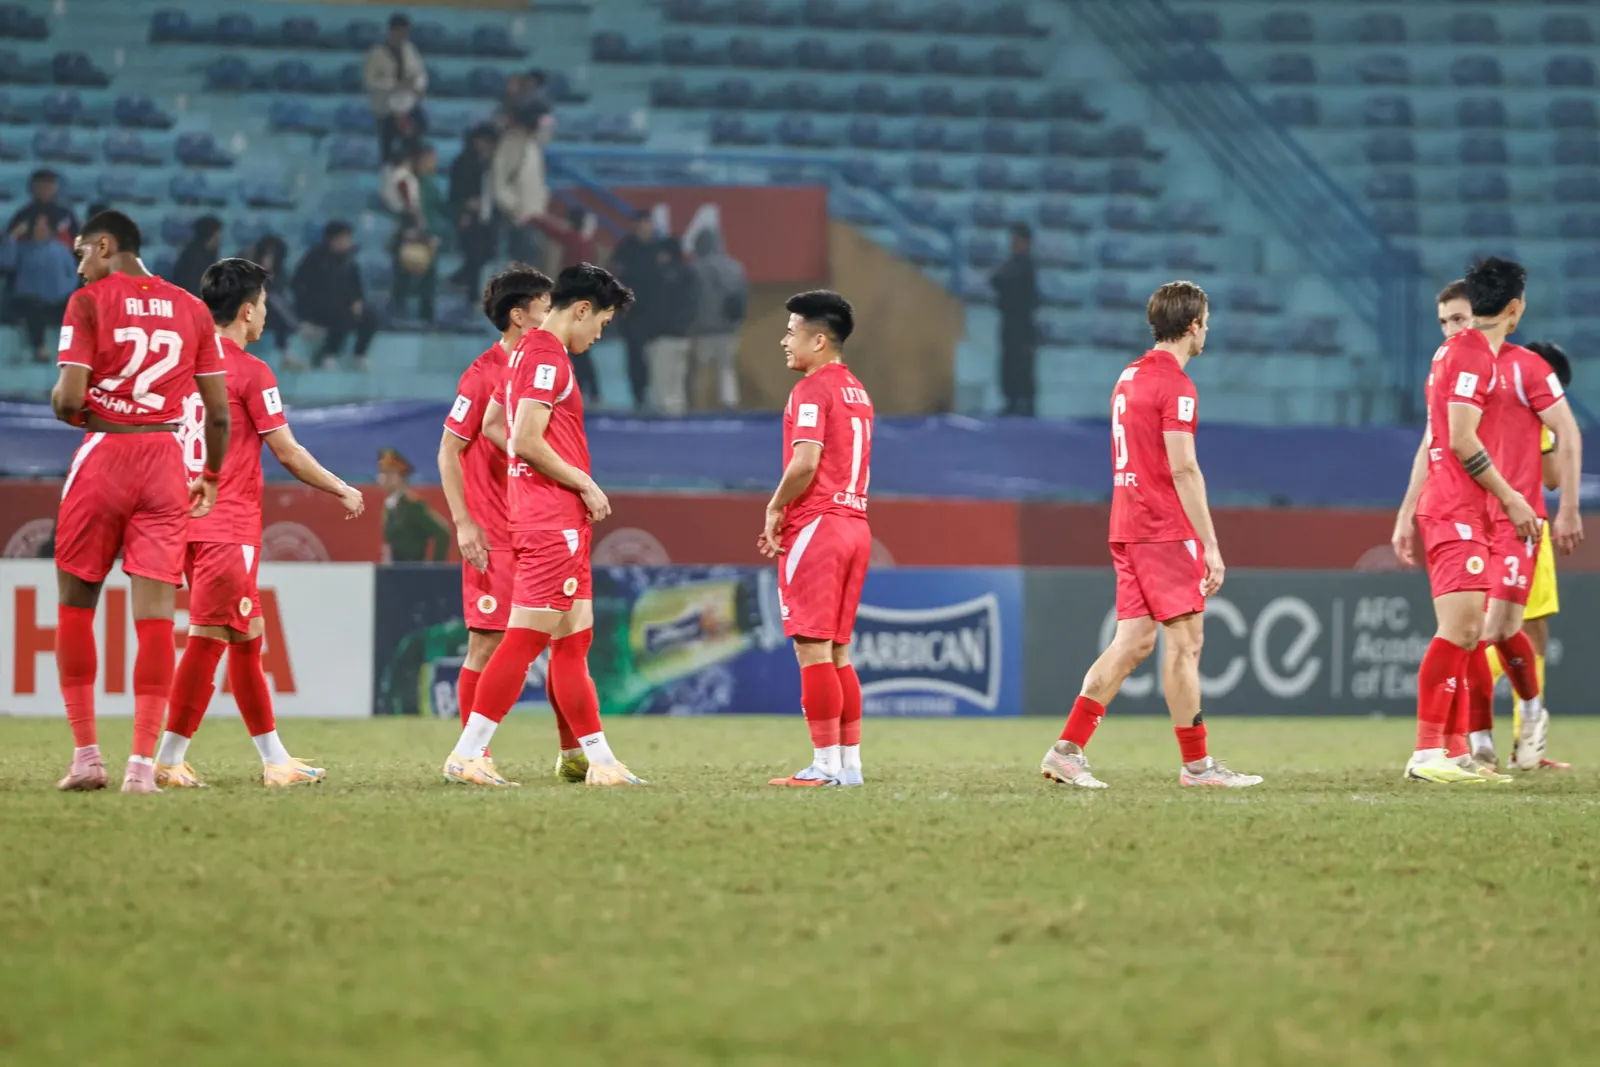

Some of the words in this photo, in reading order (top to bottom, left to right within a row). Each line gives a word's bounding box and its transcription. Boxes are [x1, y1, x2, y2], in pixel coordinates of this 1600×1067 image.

[125, 297, 174, 318] ALAN
[113, 326, 184, 410] 22
[1502, 555, 1521, 587] 3
[1354, 596, 1410, 632] AFC
